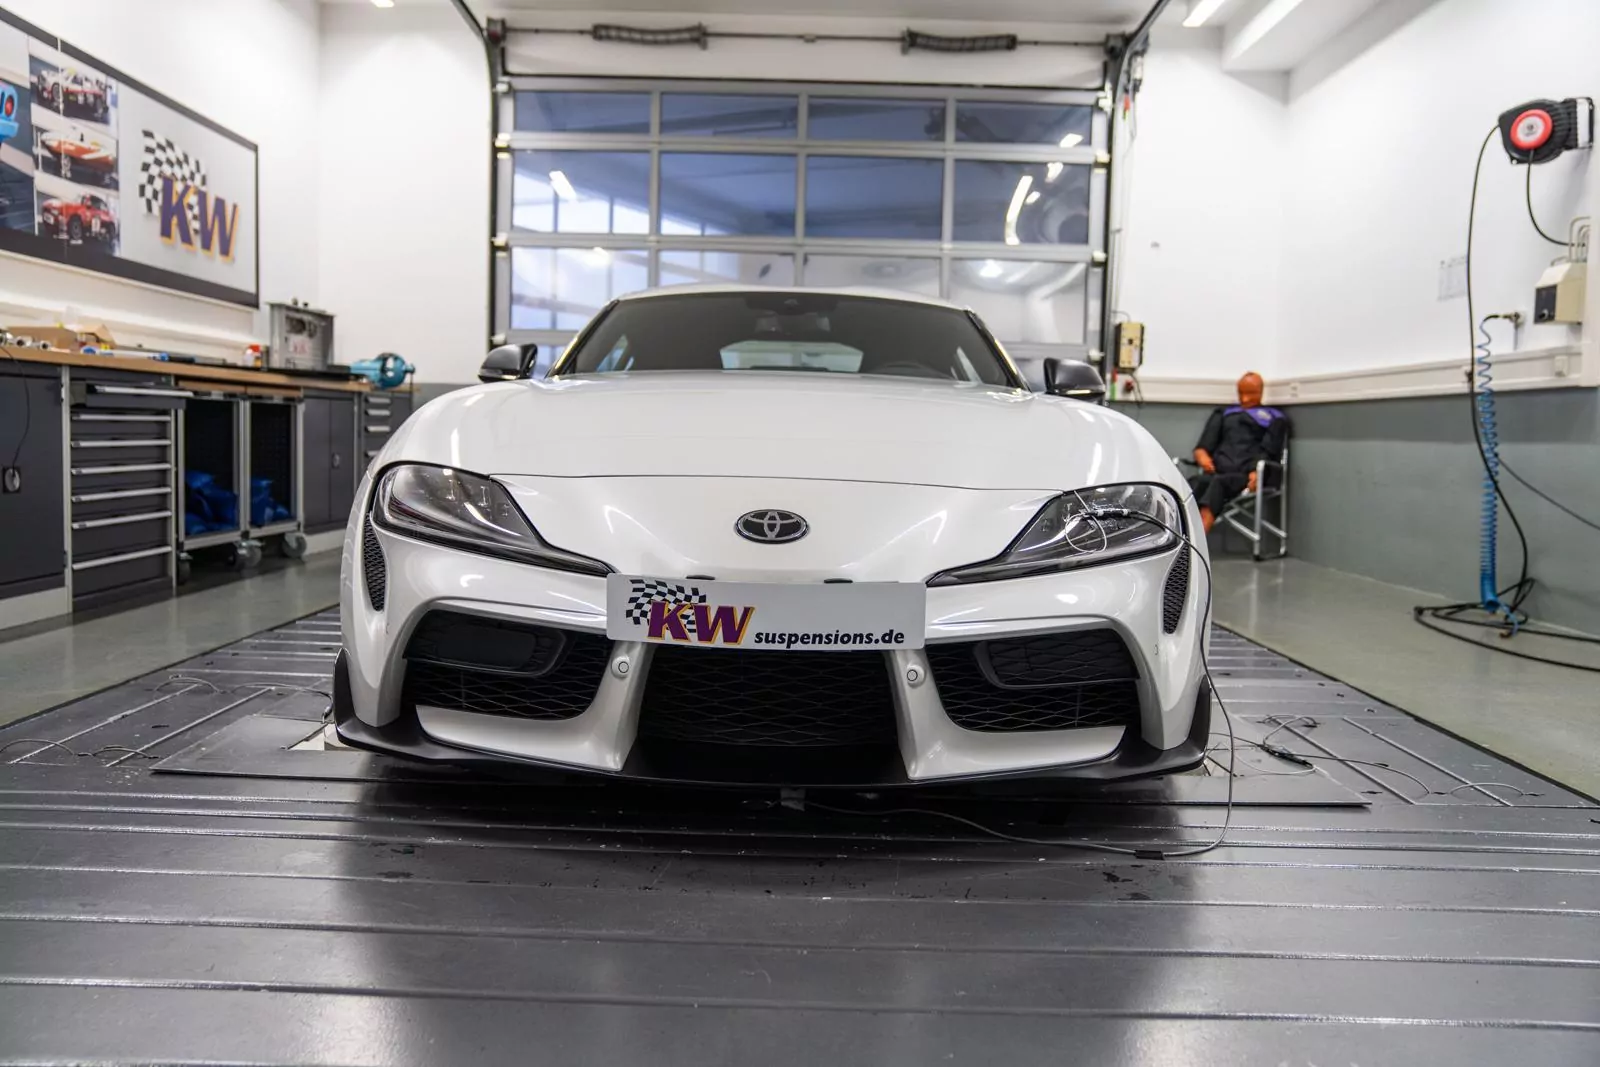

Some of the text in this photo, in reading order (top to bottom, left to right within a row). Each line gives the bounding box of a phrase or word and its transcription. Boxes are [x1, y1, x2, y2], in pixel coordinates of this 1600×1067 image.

[160, 175, 239, 263] KW
[647, 600, 905, 649] KW suspensions.de
